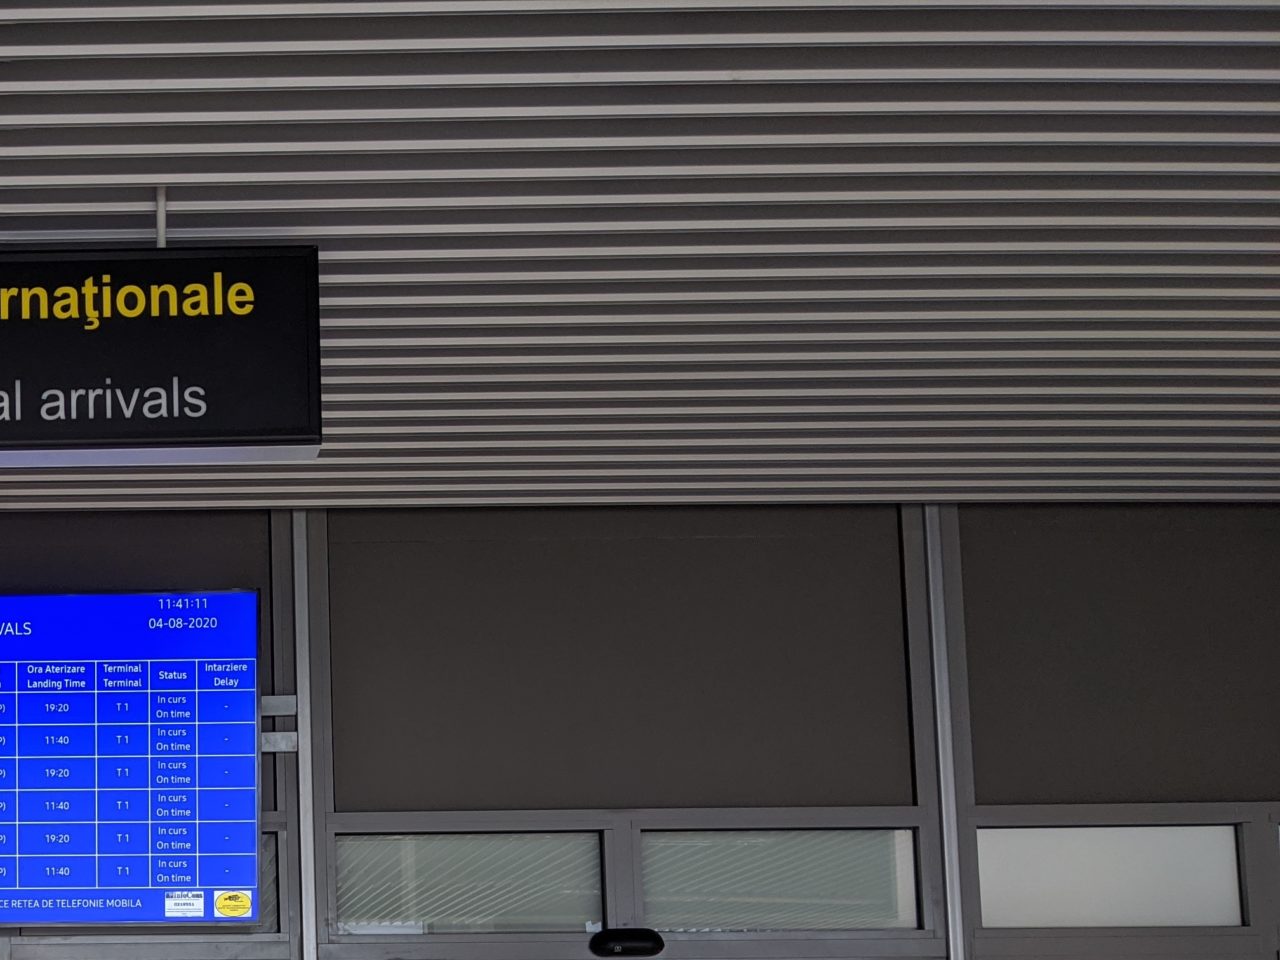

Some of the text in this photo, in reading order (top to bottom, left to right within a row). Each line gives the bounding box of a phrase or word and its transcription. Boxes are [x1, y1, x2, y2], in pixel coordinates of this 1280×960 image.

[41, 377, 206, 420] arrivals
[159, 599, 206, 609] 11:41:11
[149, 618, 217, 628] 04-08-2020
[28, 665, 85, 673] Ora Aterizare
[104, 664, 141, 672] Terminal
[206, 663, 247, 671] Intarziere
[159, 671, 187, 679] Status
[28, 679, 85, 690] Landing Time
[104, 679, 141, 687] Terminal
[214, 677, 238, 687] Delay
[45, 704, 69, 712] 19:20
[117, 703, 121, 711] T
[156, 710, 190, 718] On time
[158, 728, 166, 736] In
[46, 736, 69, 744] 11:40
[158, 761, 166, 769] In
[46, 769, 69, 777] 19:20
[117, 768, 121, 776] T
[158, 794, 166, 802] In
[46, 802, 69, 810] 11:40
[117, 801, 121, 809] T
[157, 808, 169, 816] On
[46, 835, 69, 843] 19:20
[117, 834, 122, 842] T
[157, 841, 169, 849] On
[46, 867, 69, 875] 11:40
[117, 867, 122, 875] T
[157, 874, 191, 882] On time
[12, 900, 39, 908] RETEA
[56, 899, 104, 907] TELEFONIE
[107, 899, 141, 907] MOBILA
